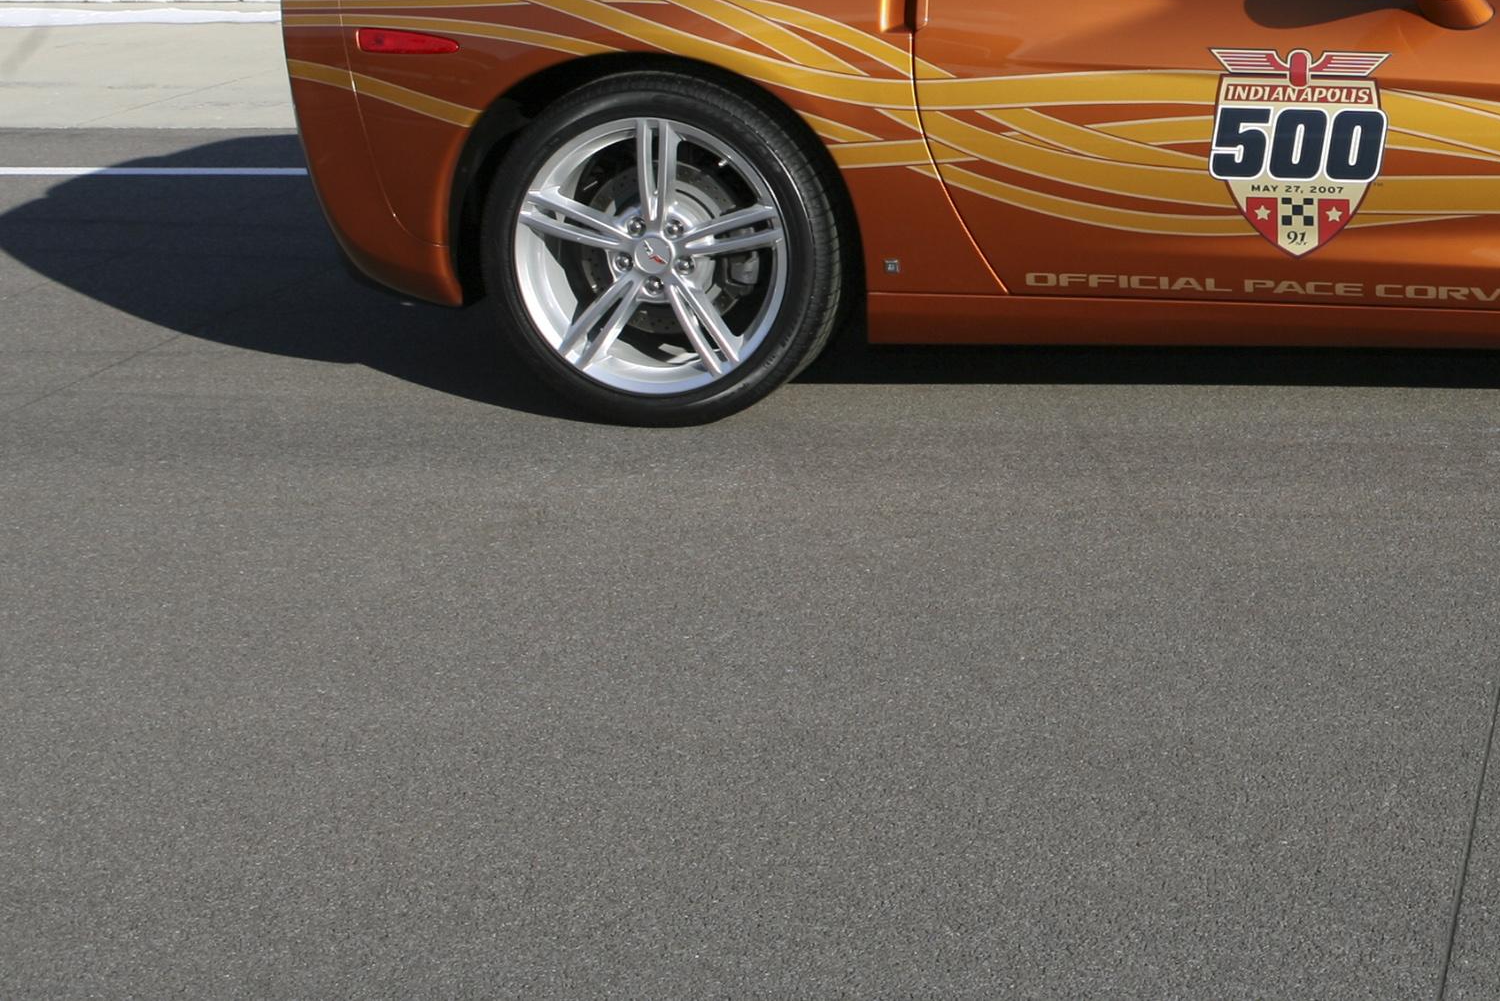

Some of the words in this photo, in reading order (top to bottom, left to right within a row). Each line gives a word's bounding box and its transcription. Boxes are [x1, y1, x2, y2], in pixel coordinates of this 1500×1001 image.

[1226, 85, 1370, 104] INDIANAPOLIS
[1209, 106, 1387, 183] 500
[1251, 184, 1278, 192] MAY
[1285, 185, 1304, 194] 27,
[1310, 185, 1344, 194] 2007
[1025, 272, 1233, 292] OFFICIAL
[1244, 278, 1364, 297] PACE
